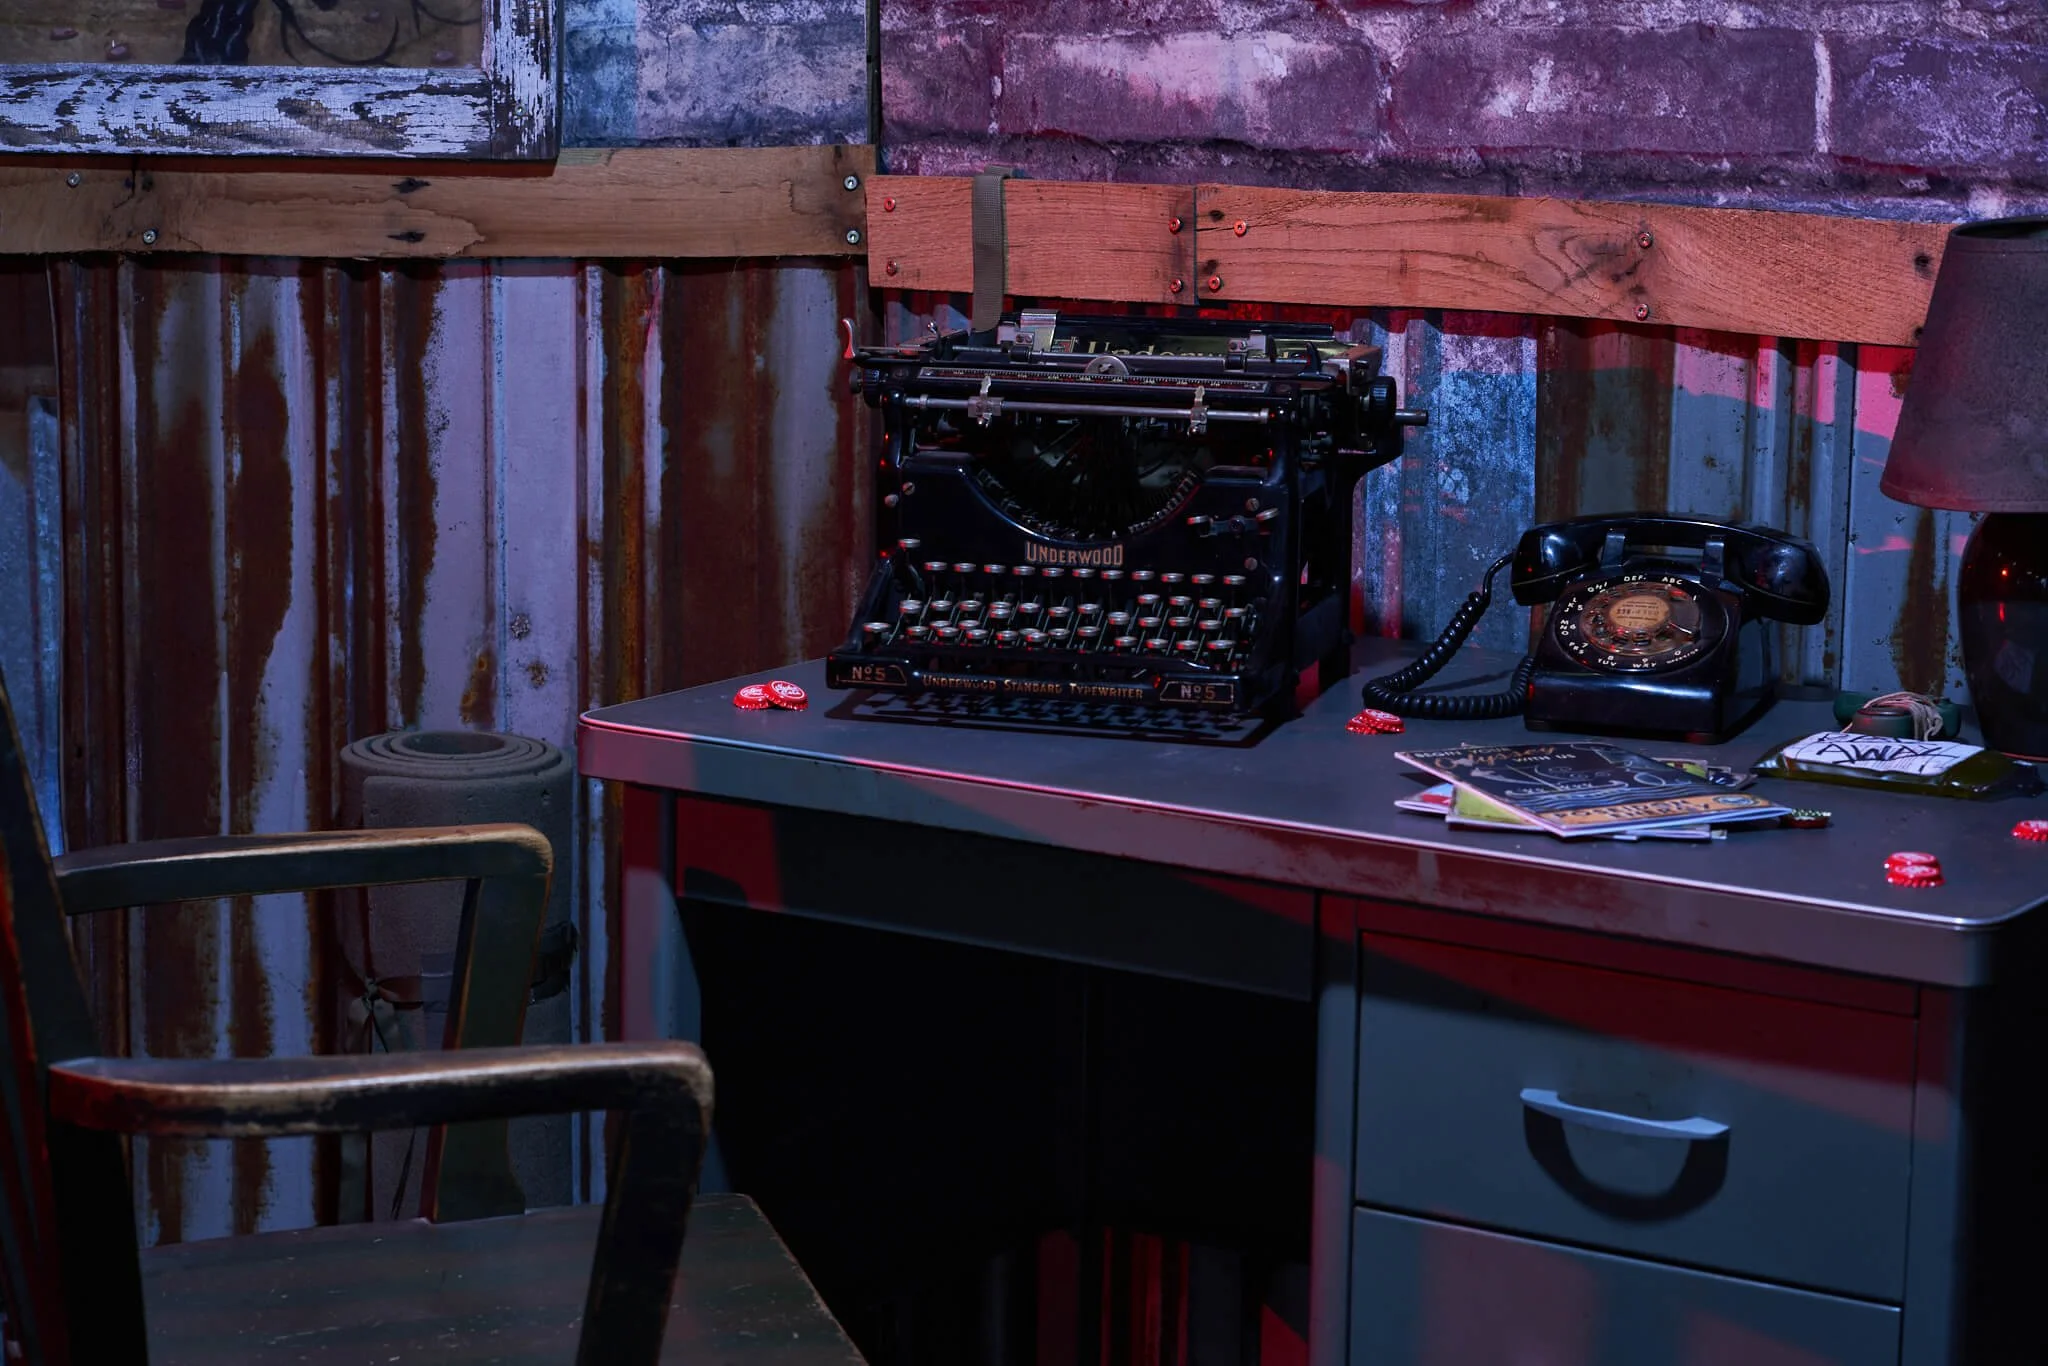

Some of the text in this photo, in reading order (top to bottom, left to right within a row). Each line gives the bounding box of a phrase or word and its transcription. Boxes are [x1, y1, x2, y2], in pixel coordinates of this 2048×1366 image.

[1025, 541, 1125, 566] UNDERWOOD
[1661, 576, 1684, 585] ABC
[922, 674, 1144, 699] UNDERWOOD STANDARD TYPEWRITER
[1816, 743, 1943, 764] AWAY
